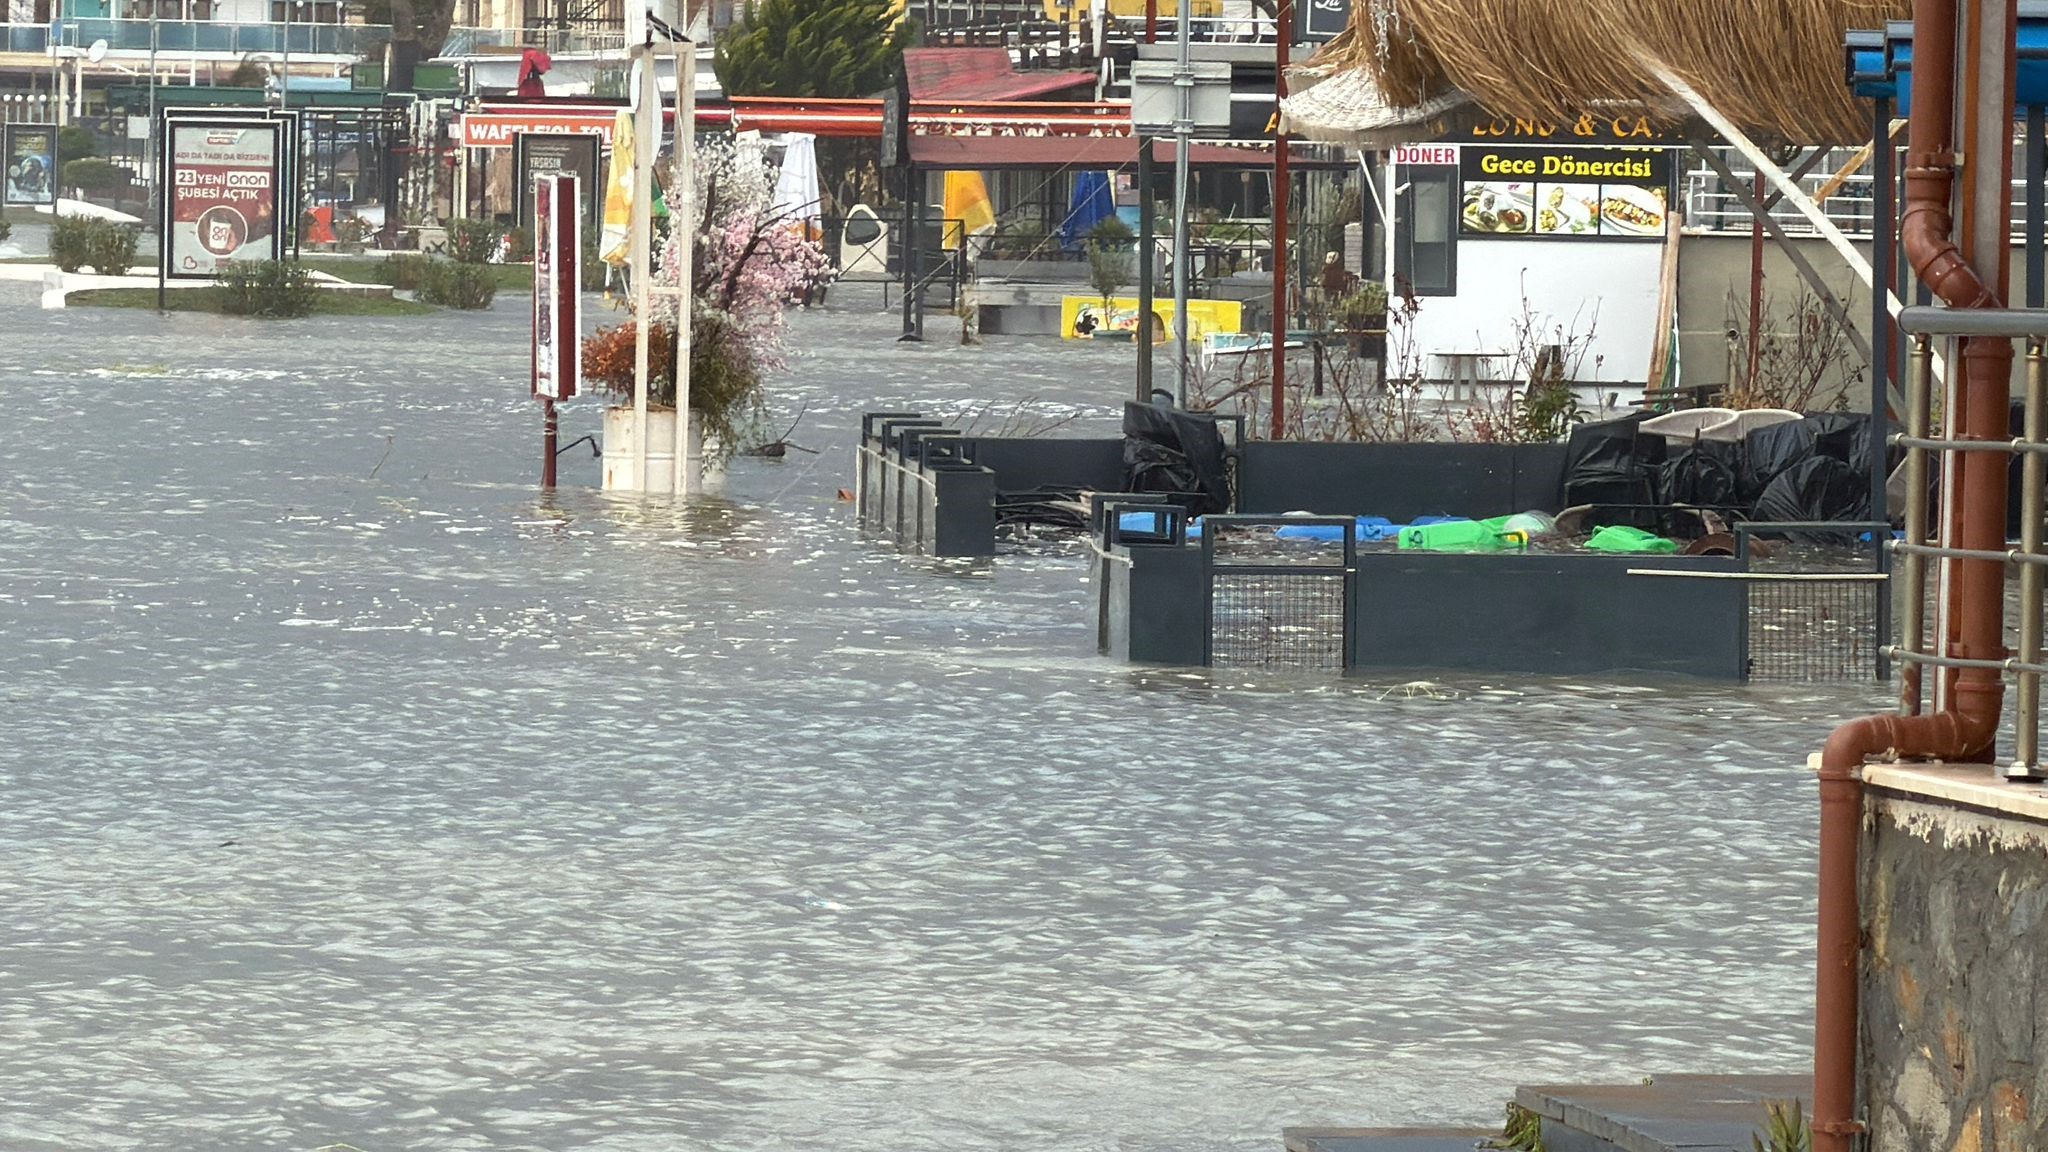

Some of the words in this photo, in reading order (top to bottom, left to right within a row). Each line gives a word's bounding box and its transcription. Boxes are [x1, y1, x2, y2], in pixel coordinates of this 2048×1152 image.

[1573, 111, 1598, 136] &
[1481, 154, 1536, 174] Gece
[1542, 155, 1652, 177] Dönercisi
[178, 172, 194, 183] 23
[196, 173, 225, 184] YENİ
[229, 175, 268, 186] onon
[178, 187, 219, 200] ŞUBESİ
[222, 189, 259, 202] AÇTIK
